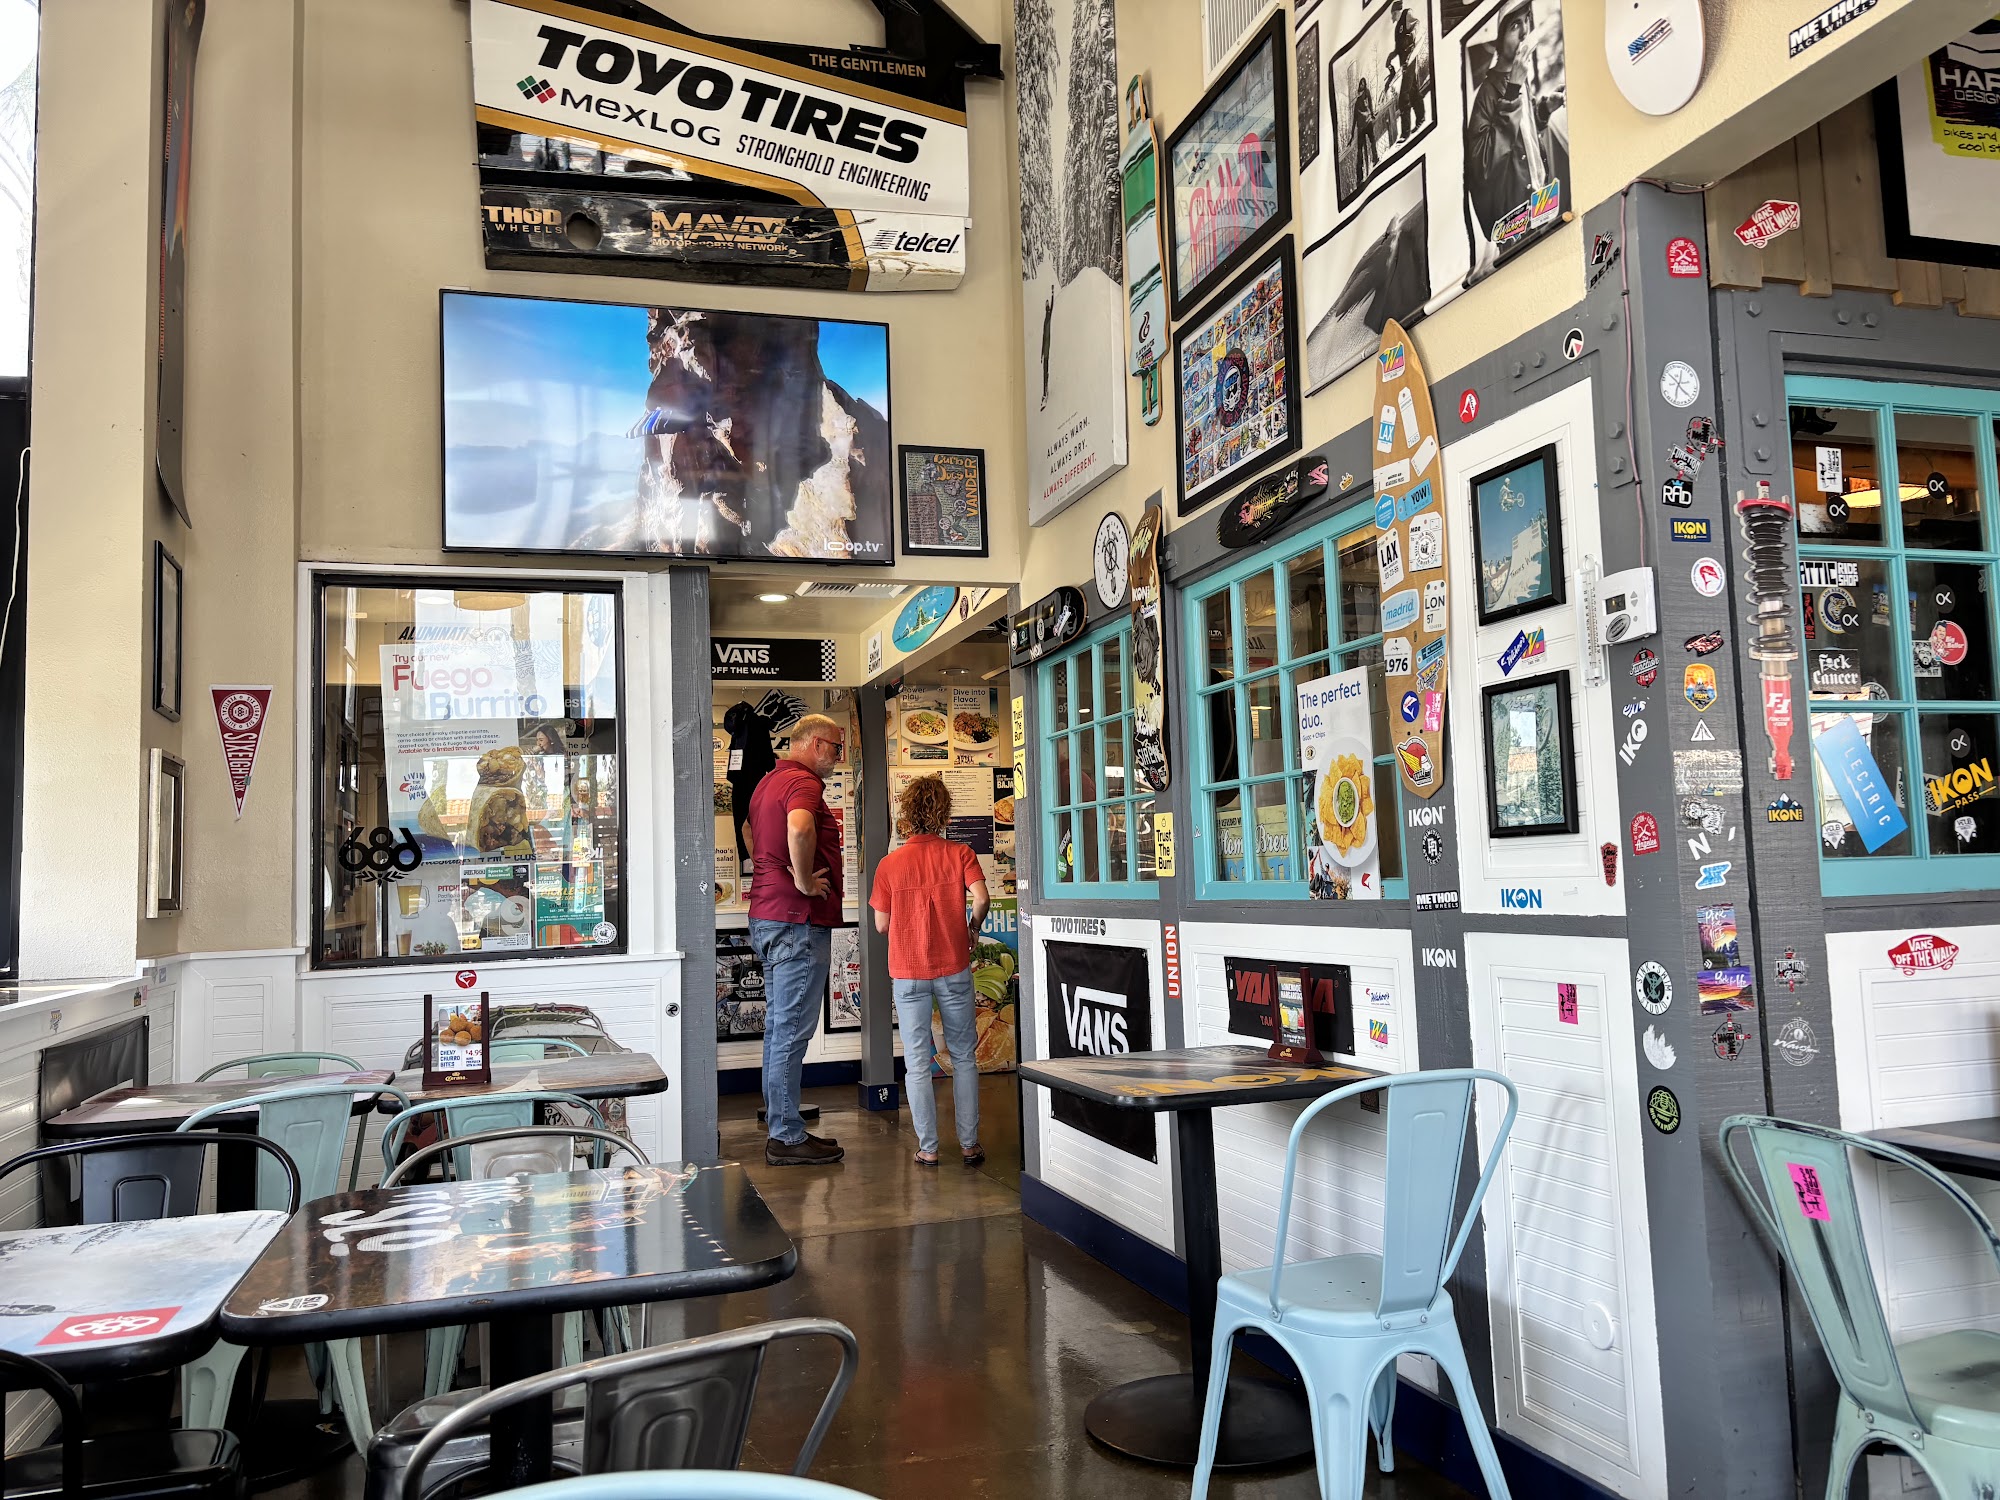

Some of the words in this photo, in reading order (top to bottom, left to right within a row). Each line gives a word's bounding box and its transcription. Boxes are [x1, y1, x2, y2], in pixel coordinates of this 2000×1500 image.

[1790, 33, 1822, 57] RACE
[809, 53, 838, 70] THE
[841, 56, 926, 78] GENTLEMEN
[537, 25, 734, 111] TOYO
[740, 78, 927, 164] TIRES
[1958, 143, 1986, 152] cool
[736, 134, 834, 176] STRONGHOLD
[838, 161, 931, 202] ENGINEERING
[481, 205, 563, 227] THOD
[1751, 206, 1774, 224] VANS
[495, 223, 563, 237] WHEELS
[1757, 216, 1776, 236] THE
[737, 241, 789, 255] NETWORK
[894, 230, 961, 255] telcel
[1047, 433, 1068, 459] ALWAYS
[1070, 416, 1090, 439] WARM.
[1379, 424, 1395, 443] LAX
[1050, 450, 1072, 475] ALWAYS
[1074, 439, 1088, 457] DRY.
[1043, 477, 1063, 500] ALWAYS
[1064, 452, 1097, 484] DIFFERENT.
[965, 458, 979, 518] VANDER
[1411, 485, 1427, 504] YOW
[1662, 485, 1692, 504] RAD
[1673, 521, 1707, 534] IKON
[1380, 540, 1399, 567] LAX
[1837, 562, 1858, 574] RIDE
[1838, 575, 1859, 587] SHOP
[1385, 598, 1414, 620] madrid
[1425, 595, 1445, 610] LON
[393, 654, 409, 665] Try
[715, 642, 771, 665] VANS
[1818, 654, 1852, 671] Fck
[730, 666, 748, 675] THE
[1813, 670, 1859, 687] Cancer
[392, 665, 493, 696] Fuego
[953, 688, 970, 696] Dive
[971, 688, 986, 696] into
[1300, 692, 1319, 710] The
[1320, 680, 1362, 709] perfect
[429, 688, 548, 721] Burrito
[1301, 712, 1323, 730] duo.
[997, 781, 1014, 789] BAJA
[1929, 757, 1996, 808] IKON
[408, 790, 427, 801] WAY
[1955, 791, 1981, 810] PASS
[1408, 807, 1446, 827] IKON
[1768, 810, 1799, 823] IKON
[1156, 829, 1171, 842] Trust
[1158, 844, 1171, 857] The
[1416, 892, 1458, 905] METHOD
[1435, 901, 1459, 910] WHEELS
[1501, 888, 1542, 909] IKON
[1909, 936, 1933, 952] VANS
[1166, 925, 1180, 997] UNION
[1422, 948, 1457, 969] IKON
[1911, 949, 1931, 966] THE
[1636, 963, 1651, 984] SINK
[1657, 965, 1672, 992] SWIM
[1640, 996, 1668, 1014] STUDIO
[1061, 983, 1129, 1054] VANS
[445, 1074, 466, 1082] Corona
